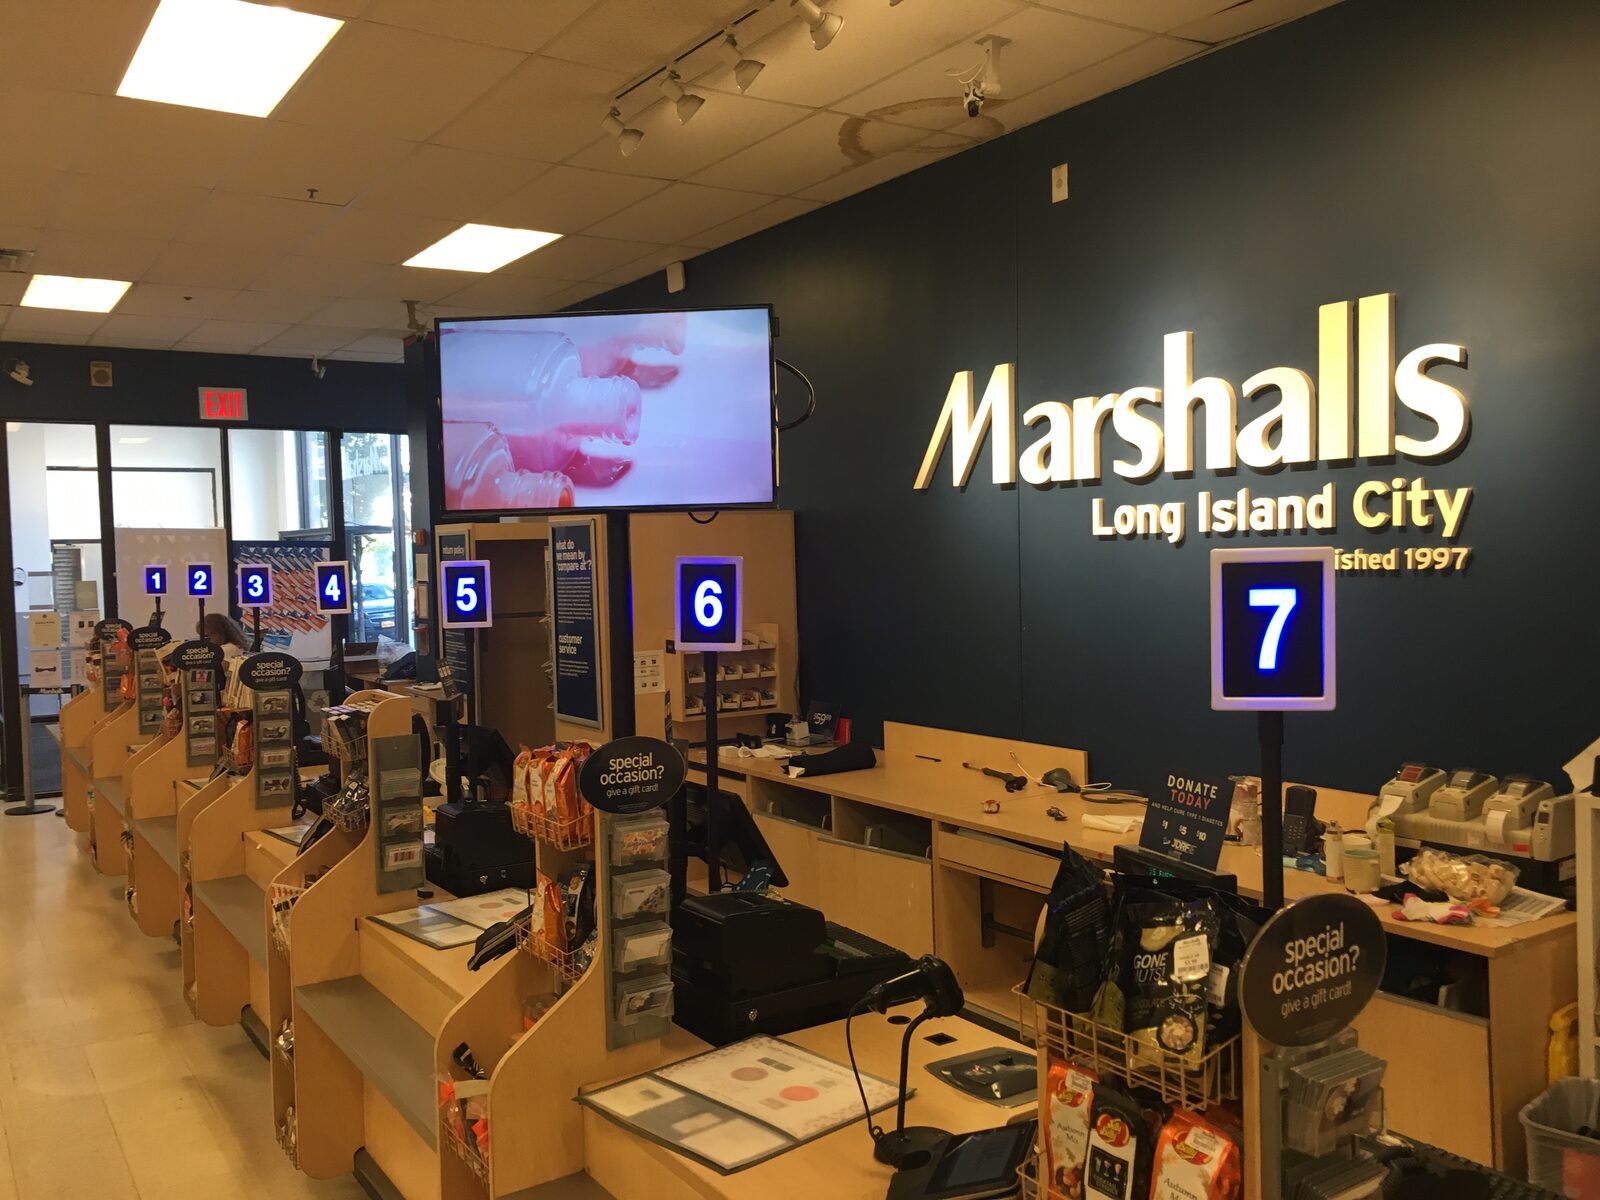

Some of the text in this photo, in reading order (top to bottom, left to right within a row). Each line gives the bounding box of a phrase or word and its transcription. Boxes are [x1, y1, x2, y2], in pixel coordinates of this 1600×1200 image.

[913, 292, 1471, 492] Marshalls
[205, 391, 242, 418] EXIT
[1092, 476, 1472, 544] Long Island City
[1404, 547, 1471, 571] 1997
[152, 572, 160, 589] 1
[194, 570, 208, 590] 2
[248, 574, 264, 597] 3
[325, 574, 340, 601] 4
[456, 578, 478, 612] 5
[694, 579, 723, 628] 6
[1248, 588, 1298, 670] 7
[251, 667, 291, 677] occasion?
[256, 660, 284, 670] special
[610, 752, 653, 772] special
[600, 766, 665, 786] occasion?
[1168, 775, 1218, 799] DONATE
[606, 788, 621, 798] give
[629, 786, 640, 796] gift
[642, 784, 659, 793] card!
[1170, 789, 1211, 810] TODAY
[1202, 816, 1223, 827] DIABETES
[1285, 921, 1344, 966] special
[1134, 952, 1168, 969] GONE
[1272, 945, 1360, 994] occasion?
[1281, 981, 1352, 1019] give a gift card!
[1057, 1122, 1084, 1138] Autumn
[1164, 1177, 1198, 1200] Autumn
